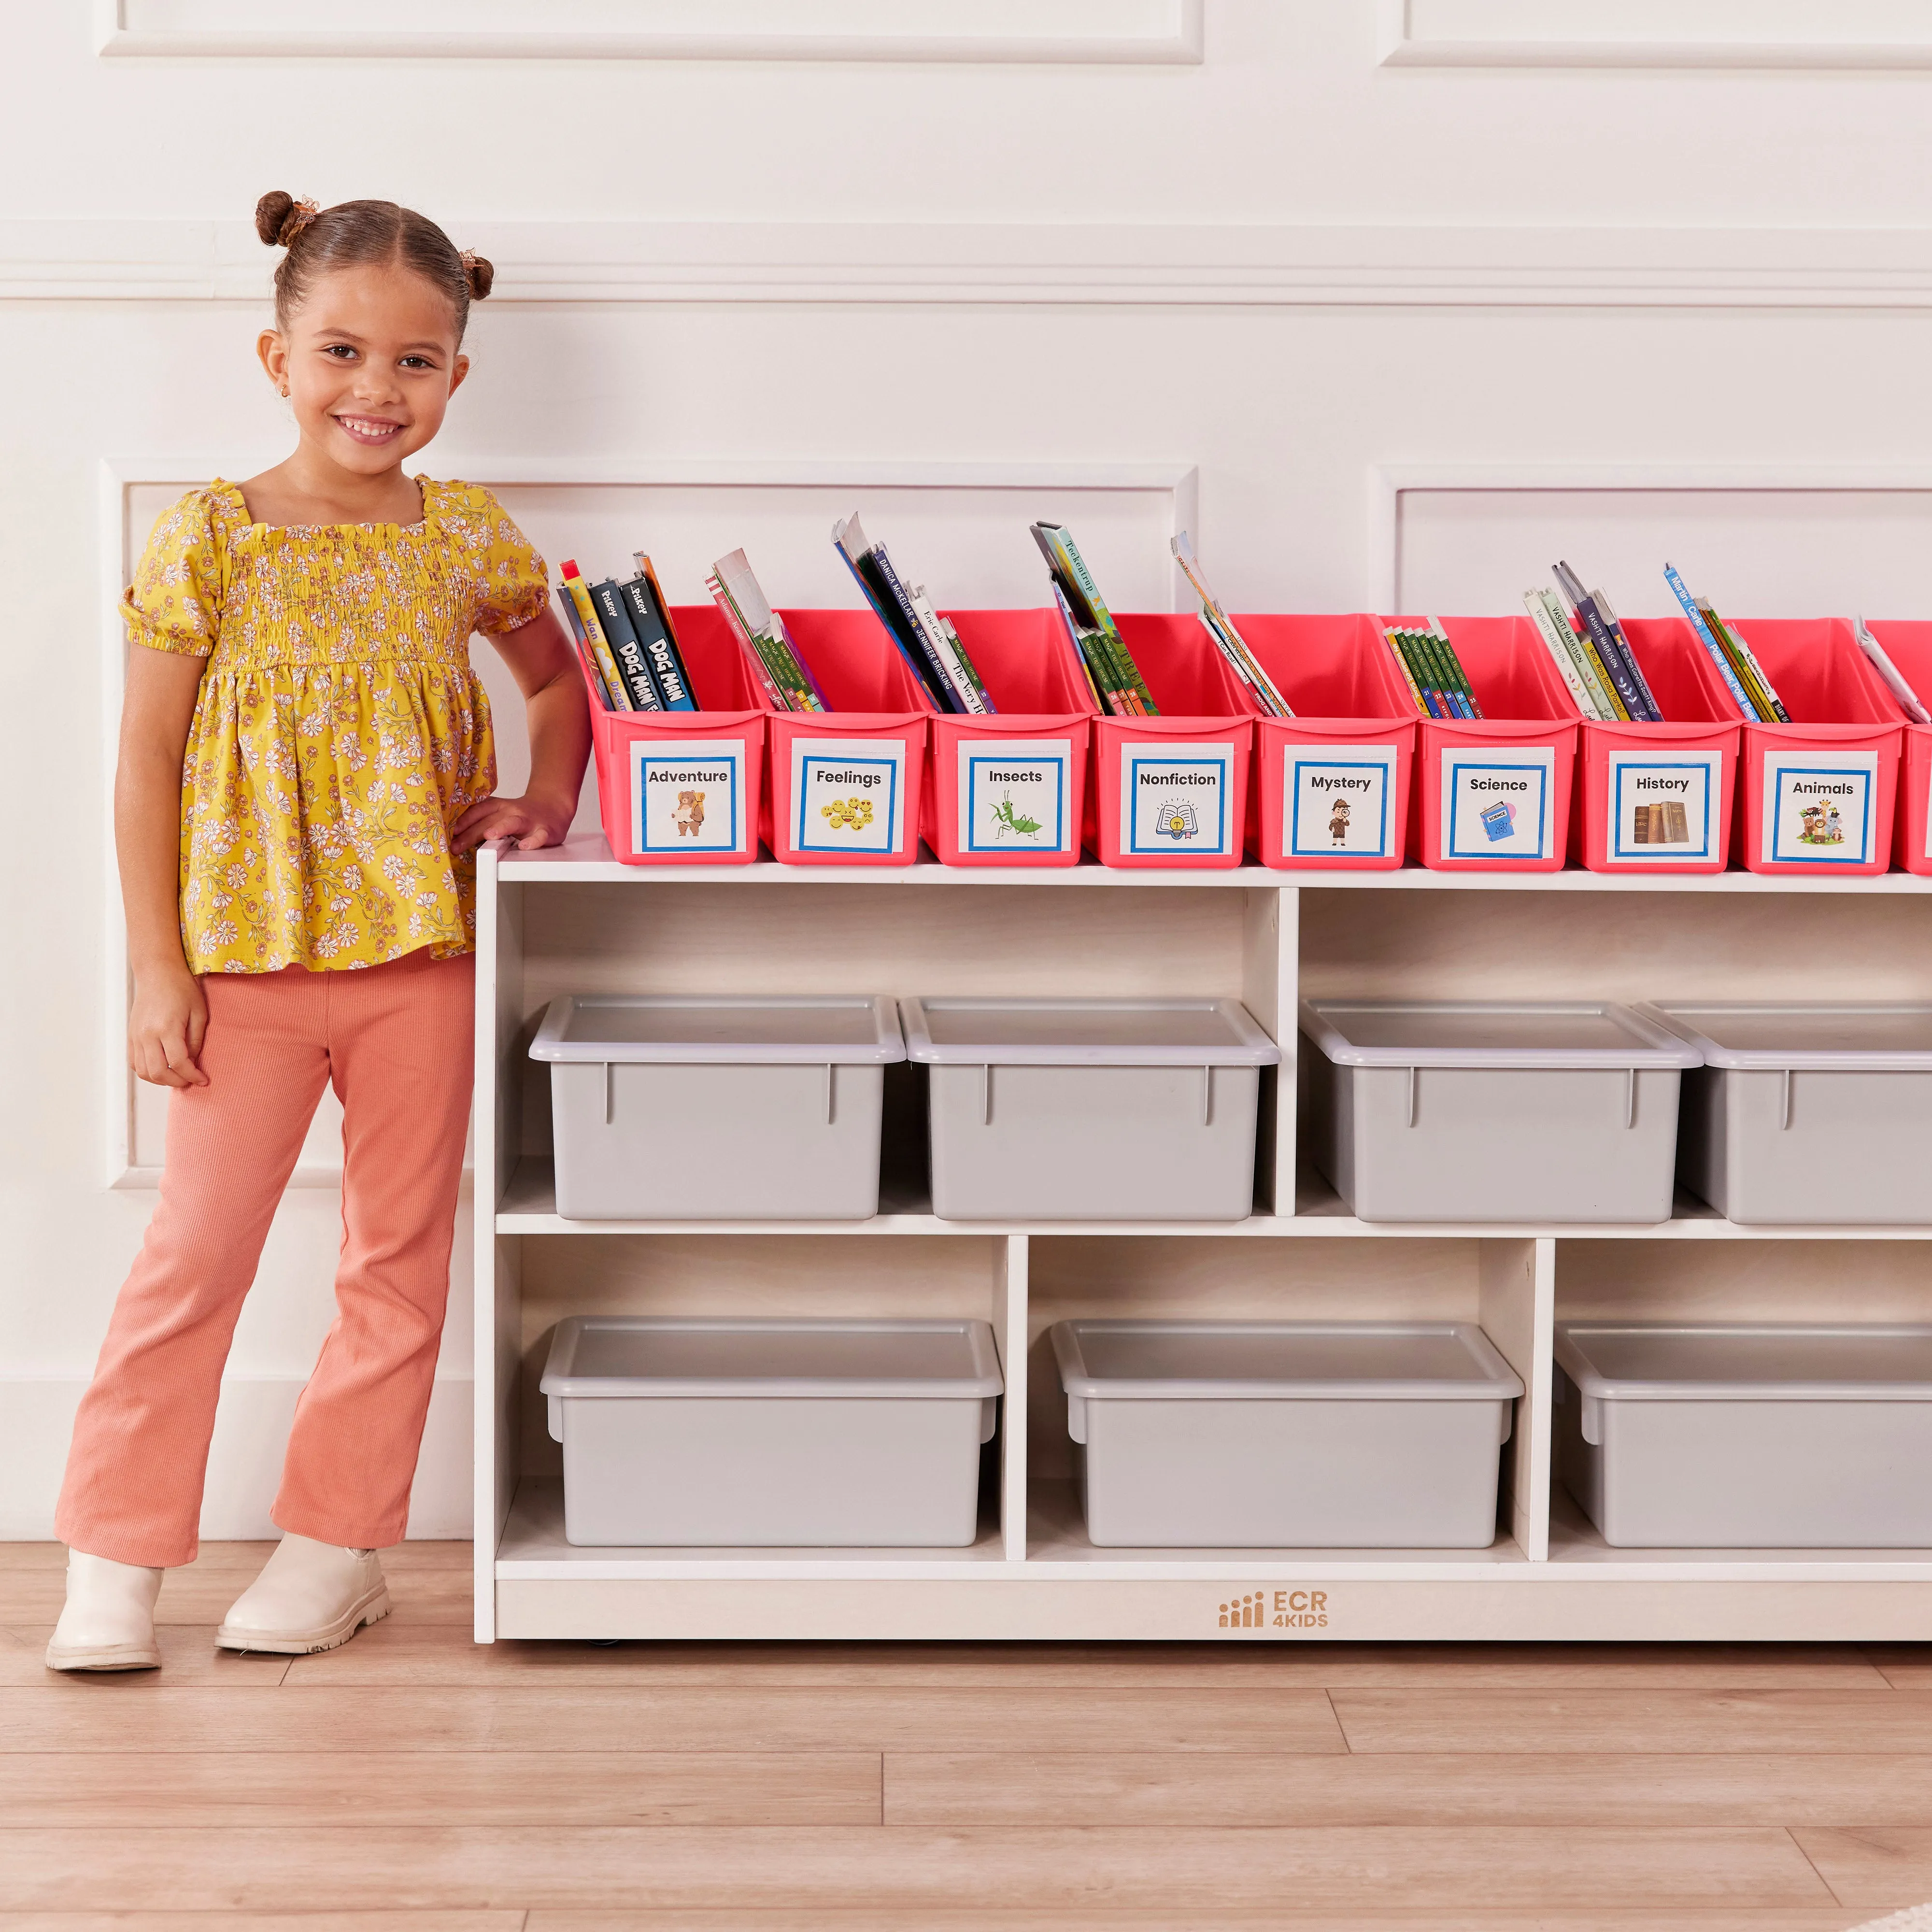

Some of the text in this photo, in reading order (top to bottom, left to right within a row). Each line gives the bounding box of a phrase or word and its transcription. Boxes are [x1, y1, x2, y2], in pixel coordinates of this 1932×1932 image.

[1065, 540, 1094, 592] Teckentrup
[879, 559, 914, 617] DANICA McKELLAR
[1672, 576, 1689, 602] Martin
[1688, 606, 1703, 626] Carle
[586, 618, 598, 639] Wan
[719, 598, 744, 640] Adams Keane
[923, 611, 943, 644] Eric Carle
[1228, 639, 1236, 649] CAN
[1236, 637, 1248, 651] LIONNI
[1536, 608, 1566, 663] VASHTI HARRISON
[1552, 606, 1583, 663] VASHTI HARRISON
[1588, 612, 1619, 668] VASHTI HARRISON
[618, 640, 645, 675] DOG
[648, 638, 685, 702] DOG MAN
[916, 628, 952, 690] JENNIFER BRICKING
[1226, 652, 1236, 665] Read!
[953, 663, 965, 682] The
[963, 682, 976, 703] Very
[1120, 649, 1146, 693] TREE
[1589, 648, 1625, 713] Who Was Rosa Parks?
[1709, 644, 1724, 664] Polar
[1720, 664, 1735, 684] Bear,
[1731, 682, 1747, 702] Polar
[630, 675, 656, 705] MAN
[1632, 668, 1643, 688] Coretta
[1641, 687, 1650, 700] Scott
[1648, 699, 1657, 713] King?
[1254, 693, 1272, 716] FROG AND
[1775, 704, 1785, 716] DIARY
[649, 771, 727, 781] Adventure
[817, 771, 881, 788] Feelings
[990, 771, 1042, 781] Insects
[1141, 773, 1215, 784] Nonfiction
[1312, 777, 1371, 792] Mystery
[1471, 778, 1527, 790] Science
[1637, 777, 1689, 792] History
[1793, 782, 1853, 794] Animals
[1489, 811, 1506, 821] SCIENCE
[1274, 1591, 1328, 1611] ECR
[1272, 1614, 1328, 1627] 4KIDS
